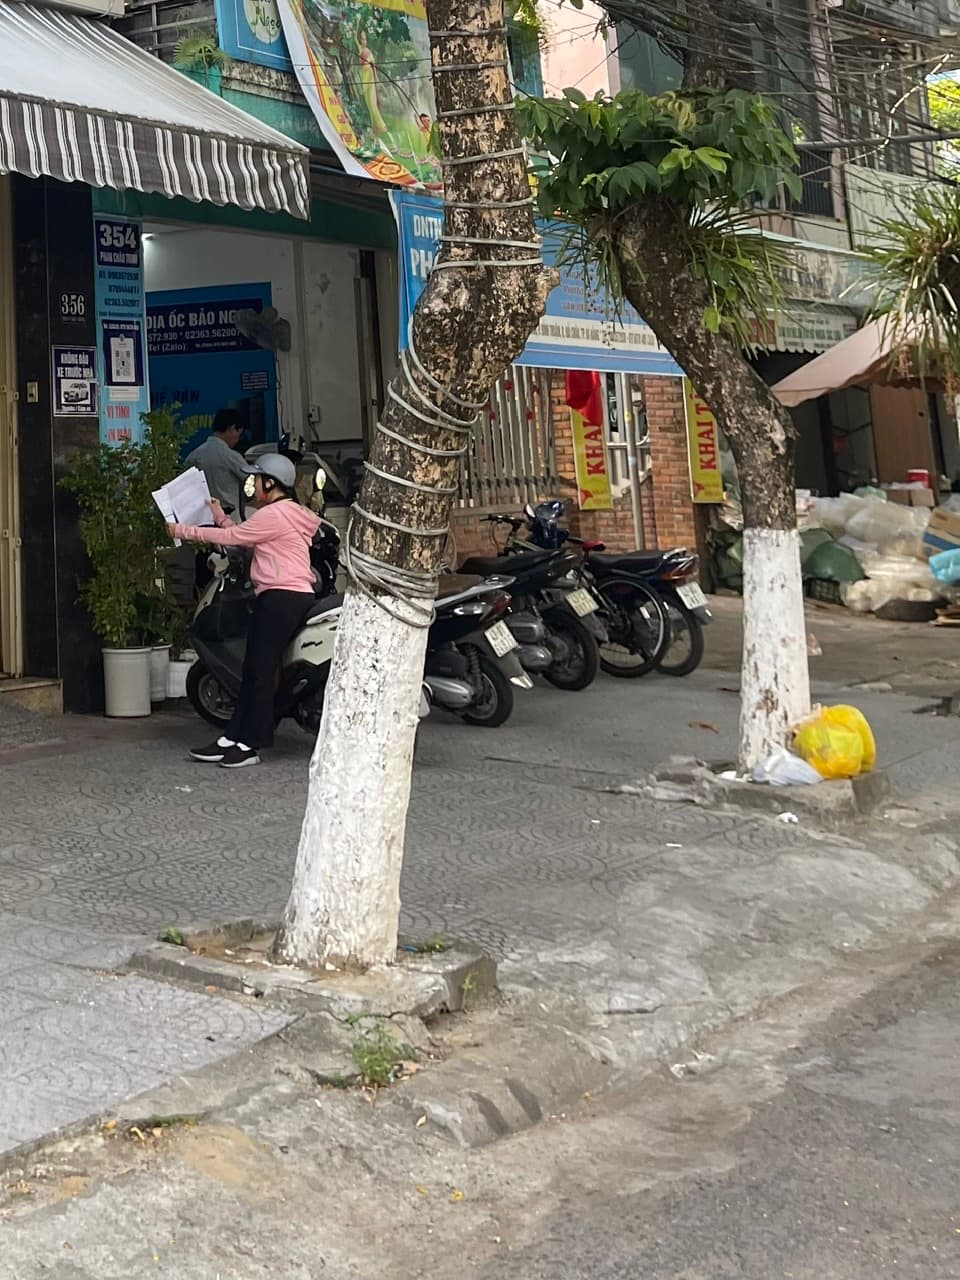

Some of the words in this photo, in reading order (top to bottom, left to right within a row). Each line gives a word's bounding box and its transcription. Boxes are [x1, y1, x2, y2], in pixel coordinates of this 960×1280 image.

[100, 224, 137, 249] 354
[61, 294, 85, 315] 356
[169, 309, 185, 328] ỐC
[189, 307, 215, 326] BẢO
[696, 421, 717, 470] KHAI
